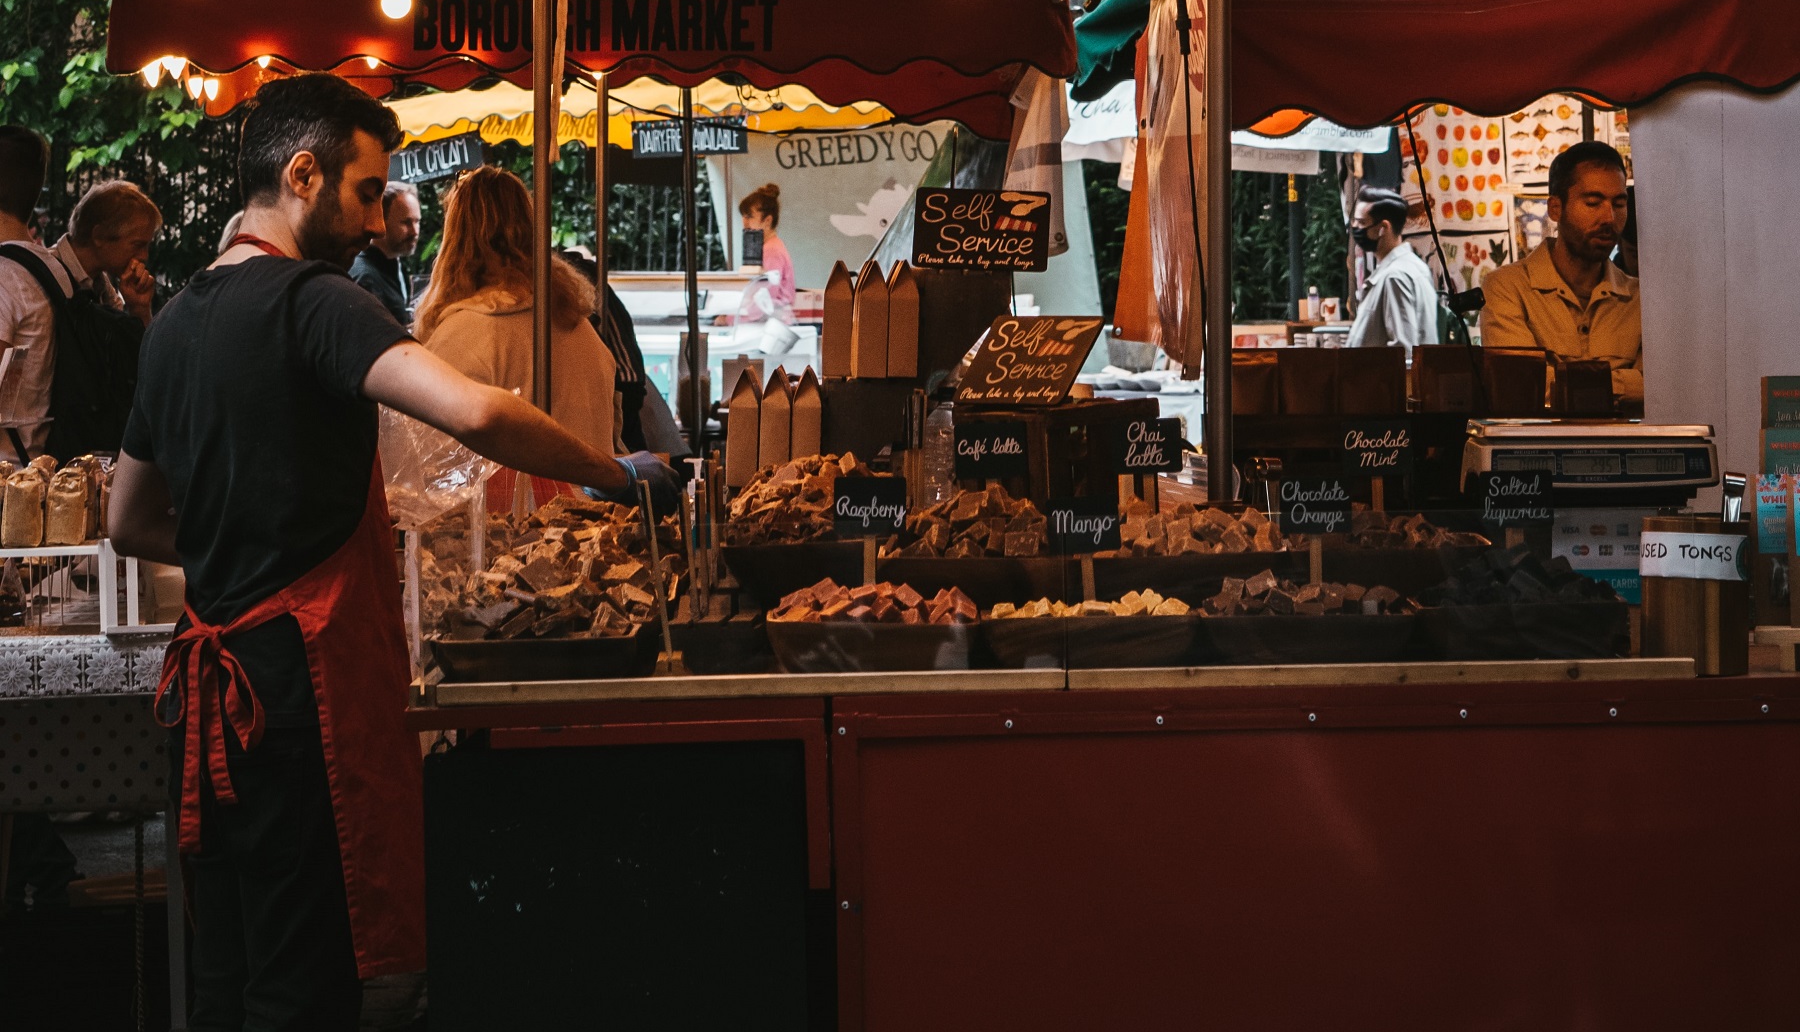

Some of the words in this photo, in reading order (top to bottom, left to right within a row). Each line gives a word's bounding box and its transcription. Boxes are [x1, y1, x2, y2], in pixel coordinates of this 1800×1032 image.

[693, 127, 740, 151] AVAILABLE
[775, 130, 896, 170] GREEDY
[399, 149, 424, 180] ICE
[425, 138, 469, 173] CREAM
[921, 193, 995, 232] Self
[936, 224, 1034, 255] Service
[918, 253, 944, 264] Please
[977, 255, 991, 270] bag
[994, 255, 1009, 266] and
[988, 319, 1054, 356] Self
[985, 351, 1068, 384] Service
[960, 386, 983, 399] Please
[1012, 387, 1024, 403] bag
[1026, 387, 1041, 398] and
[1127, 421, 1166, 443] Chai
[1344, 429, 1410, 450] Chocolate
[957, 437, 988, 461] Café
[991, 437, 1023, 455] latte
[1124, 443, 1170, 467] latte
[1360, 449, 1399, 467] Mint
[1281, 480, 1350, 502] Chocolate
[1488, 474, 1542, 497] Salted
[836, 495, 907, 528] Raspberry
[1290, 503, 1345, 533] Orange
[1483, 496, 1550, 527] liquorice
[1051, 509, 1116, 545] Mango
[1561, 526, 1579, 534] VISA
[1641, 543, 1667, 558] USED
[1679, 544, 1732, 563] TONGS
[1611, 578, 1638, 589] CARDS
